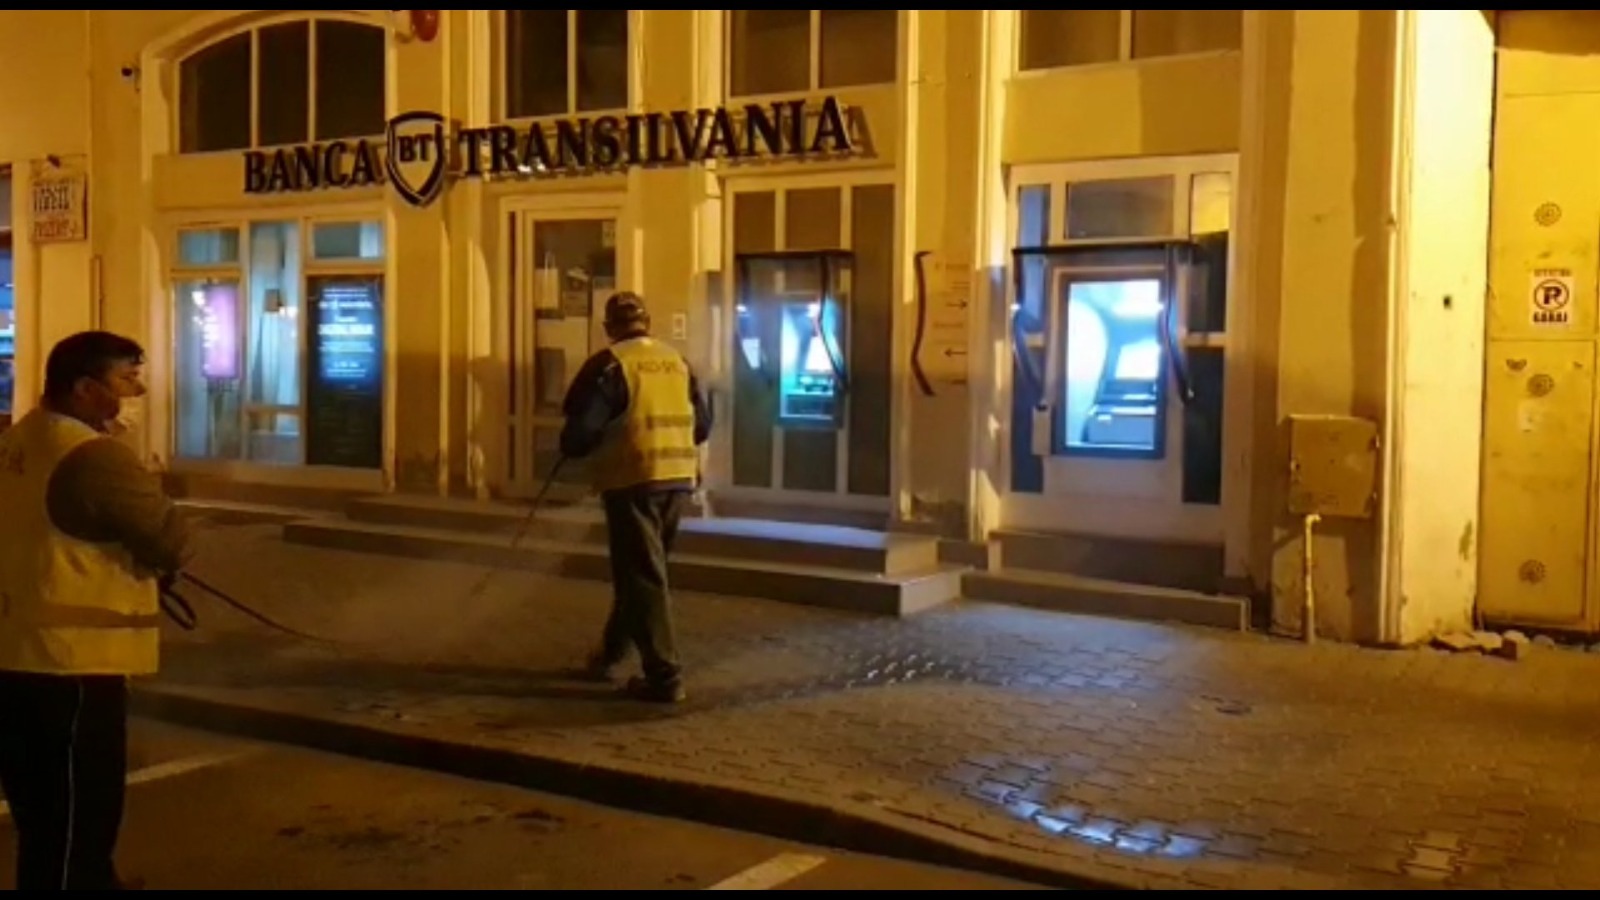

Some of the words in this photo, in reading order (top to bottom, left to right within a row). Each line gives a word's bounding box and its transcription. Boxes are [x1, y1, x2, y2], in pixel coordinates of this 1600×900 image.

[244, 139, 376, 193] BANCA
[398, 134, 433, 162] BT
[459, 95, 851, 176] TRANSILVANIA
